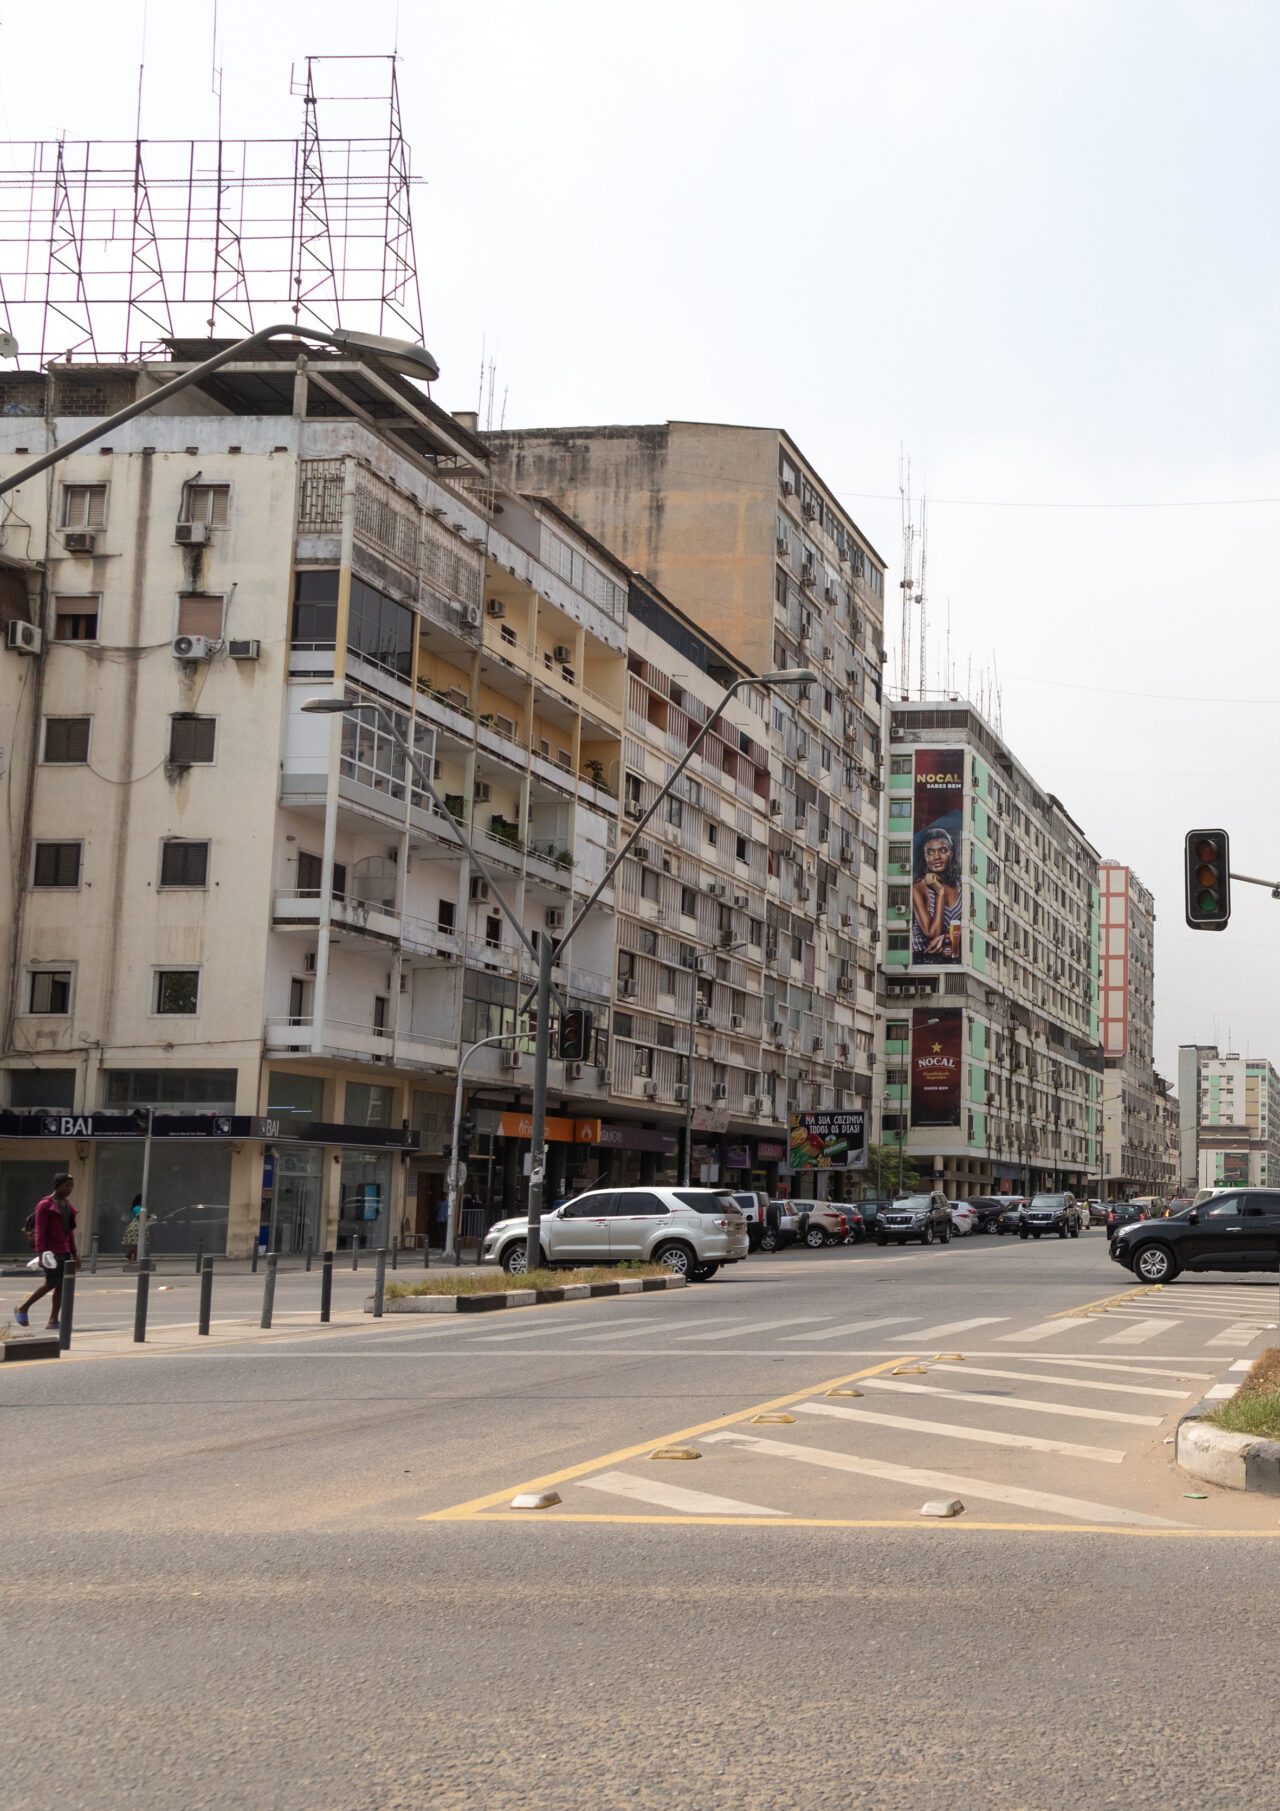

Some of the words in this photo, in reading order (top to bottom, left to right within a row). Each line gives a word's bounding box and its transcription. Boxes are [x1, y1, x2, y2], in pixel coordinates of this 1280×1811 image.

[917, 774, 961, 783] NOCAL
[918, 1057, 956, 1068] NOCAL
[805, 1115, 817, 1125] NA
[818, 1115, 831, 1125] SUA
[833, 1115, 864, 1124] COZINHA
[61, 1117, 93, 1135] BAI
[266, 1119, 280, 1137] BAI
[809, 1124, 829, 1134] TODOS
[831, 1124, 839, 1134] OS
[842, 1124, 860, 1134] DIAS!
